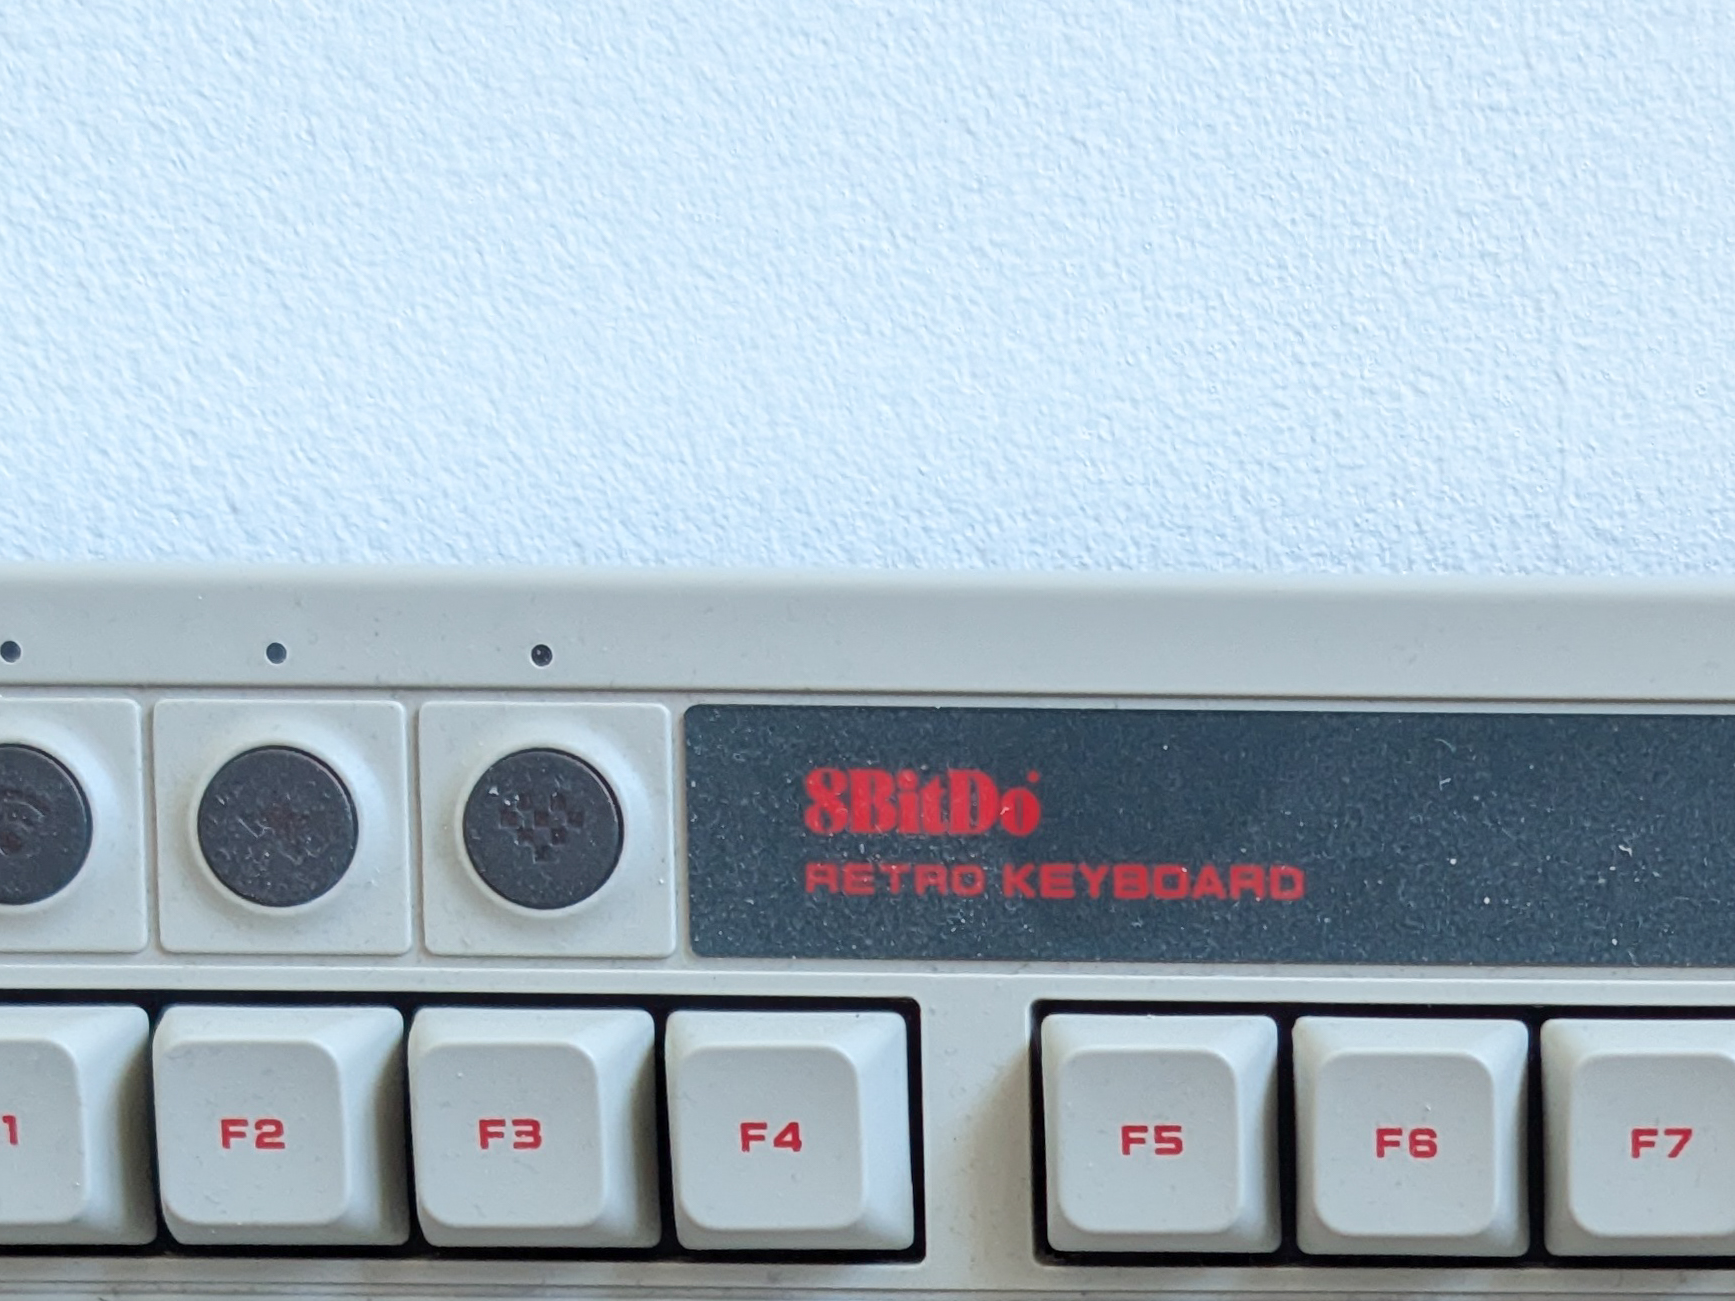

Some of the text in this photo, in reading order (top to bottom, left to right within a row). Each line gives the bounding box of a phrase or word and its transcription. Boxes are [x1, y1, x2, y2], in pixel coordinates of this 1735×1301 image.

[804, 767, 1041, 837] 8BitDo
[804, 862, 1305, 900] RETRO KEYBOARD
[221, 1119, 284, 1149] F2
[479, 1119, 542, 1149] F3
[740, 1122, 802, 1152] F4
[1121, 1125, 1182, 1156] F5
[1376, 1128, 1438, 1158] F6
[1632, 1128, 1692, 1158] F7
